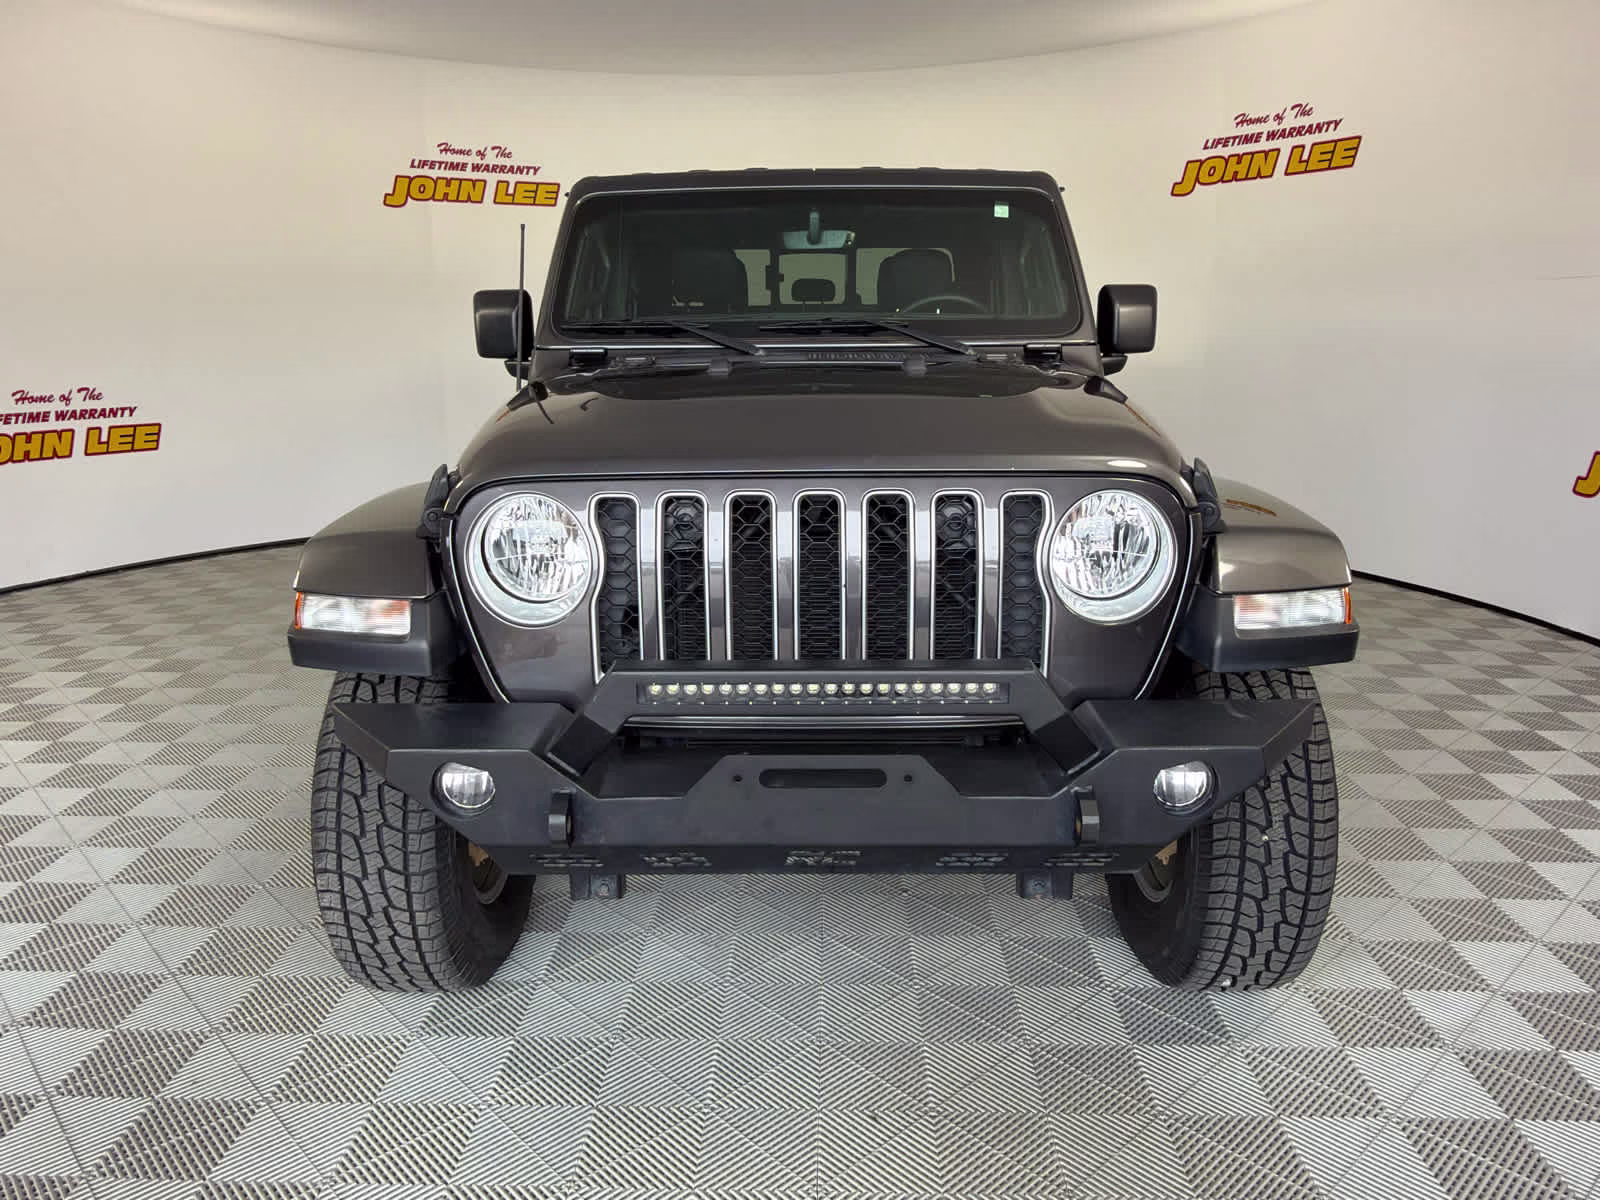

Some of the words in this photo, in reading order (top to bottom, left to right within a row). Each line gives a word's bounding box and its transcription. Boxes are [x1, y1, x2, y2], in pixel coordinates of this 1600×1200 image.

[1233, 112, 1270, 128] Home
[1273, 107, 1287, 126] of
[1291, 102, 1314, 119] The
[1202, 131, 1263, 151] LIFETIME
[1265, 117, 1343, 142] WARRANTY
[437, 142, 473, 157] Home
[475, 147, 488, 161] of
[491, 145, 513, 159] The
[410, 158, 468, 173] LIFETIME
[470, 162, 541, 176] WARRANTY
[1171, 148, 1281, 197] JOHN
[1284, 135, 1362, 176] LEE
[383, 175, 487, 207] JOHN
[493, 180, 561, 207] LEE
[11, 390, 55, 405] Home
[58, 390, 72, 406] of
[77, 387, 104, 402] The
[54, 406, 137, 422] WARRANTY
[84, 423, 162, 456] LEE
